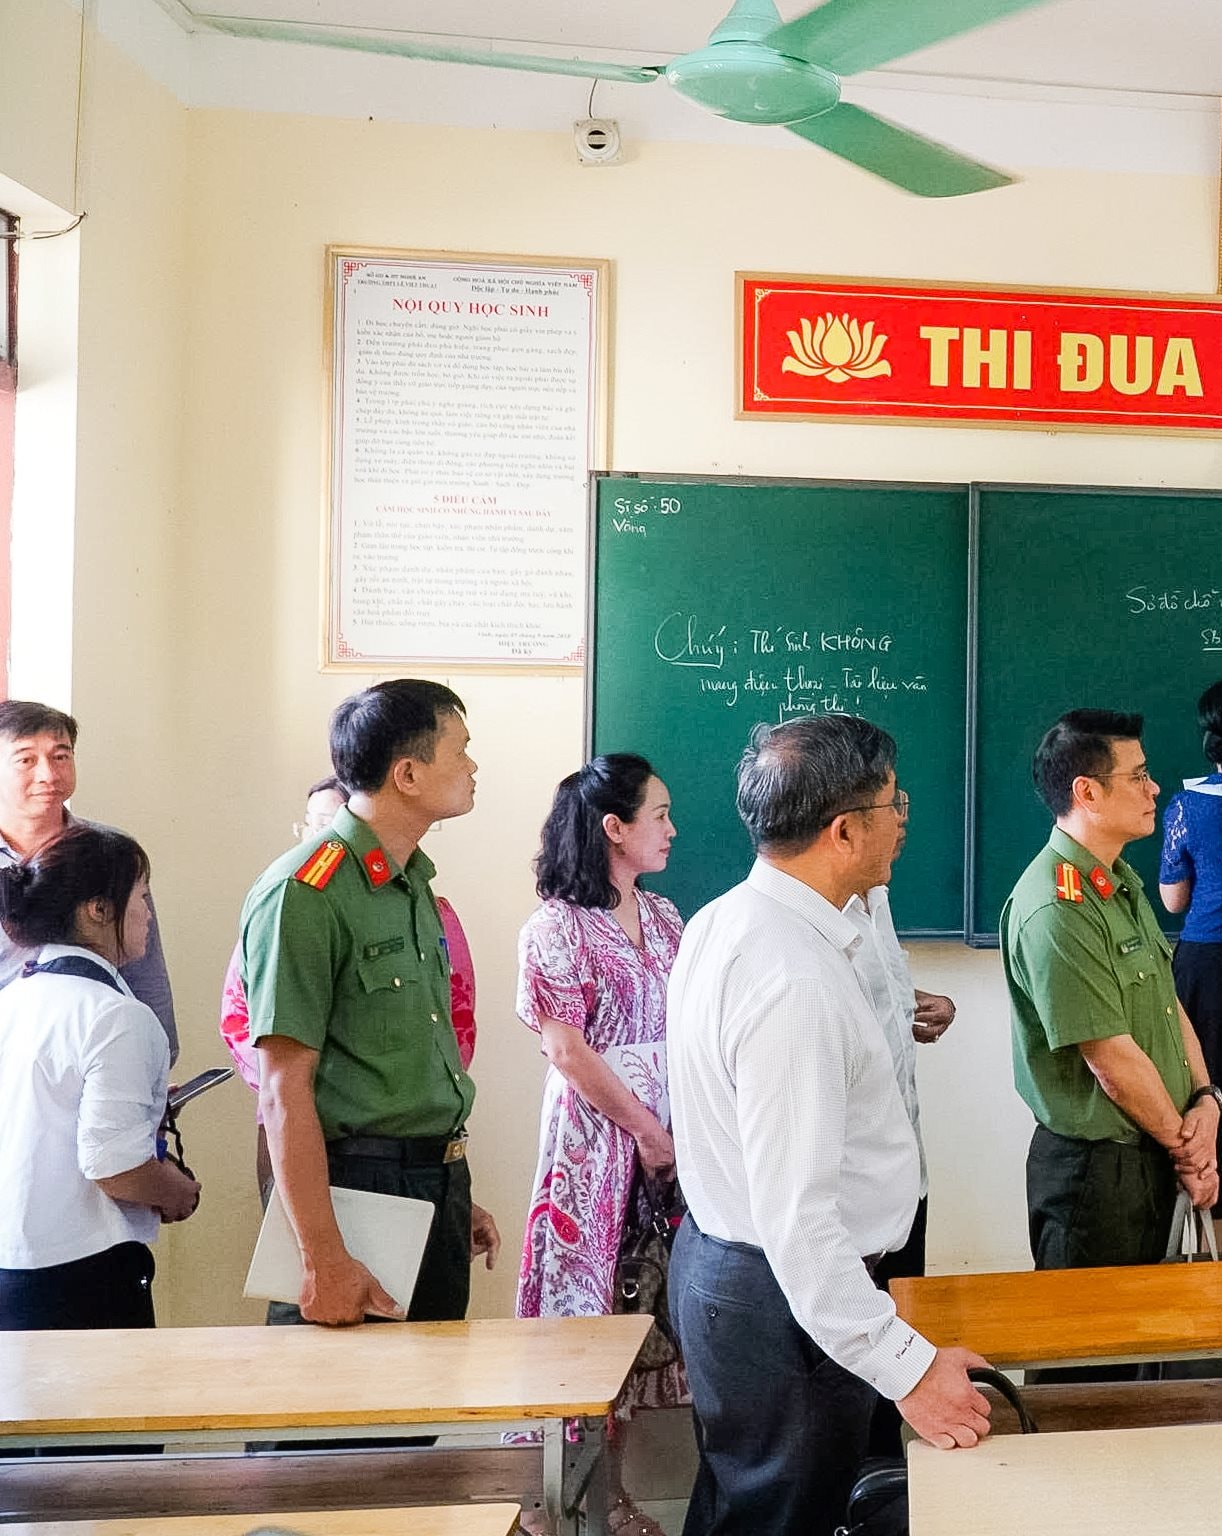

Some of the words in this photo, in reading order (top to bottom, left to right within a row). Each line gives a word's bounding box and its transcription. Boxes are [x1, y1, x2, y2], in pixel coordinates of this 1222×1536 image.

[392, 298, 423, 312] NỘI
[428, 300, 463, 315] QUY
[469, 303, 506, 318] HỌC
[509, 304, 549, 318] SINH
[919, 325, 1033, 390] THI
[1057, 332, 1204, 397] ĐUA
[660, 497, 681, 514] 50
[821, 627, 893, 653] KHÔNG
[700, 677, 738, 707] mang
